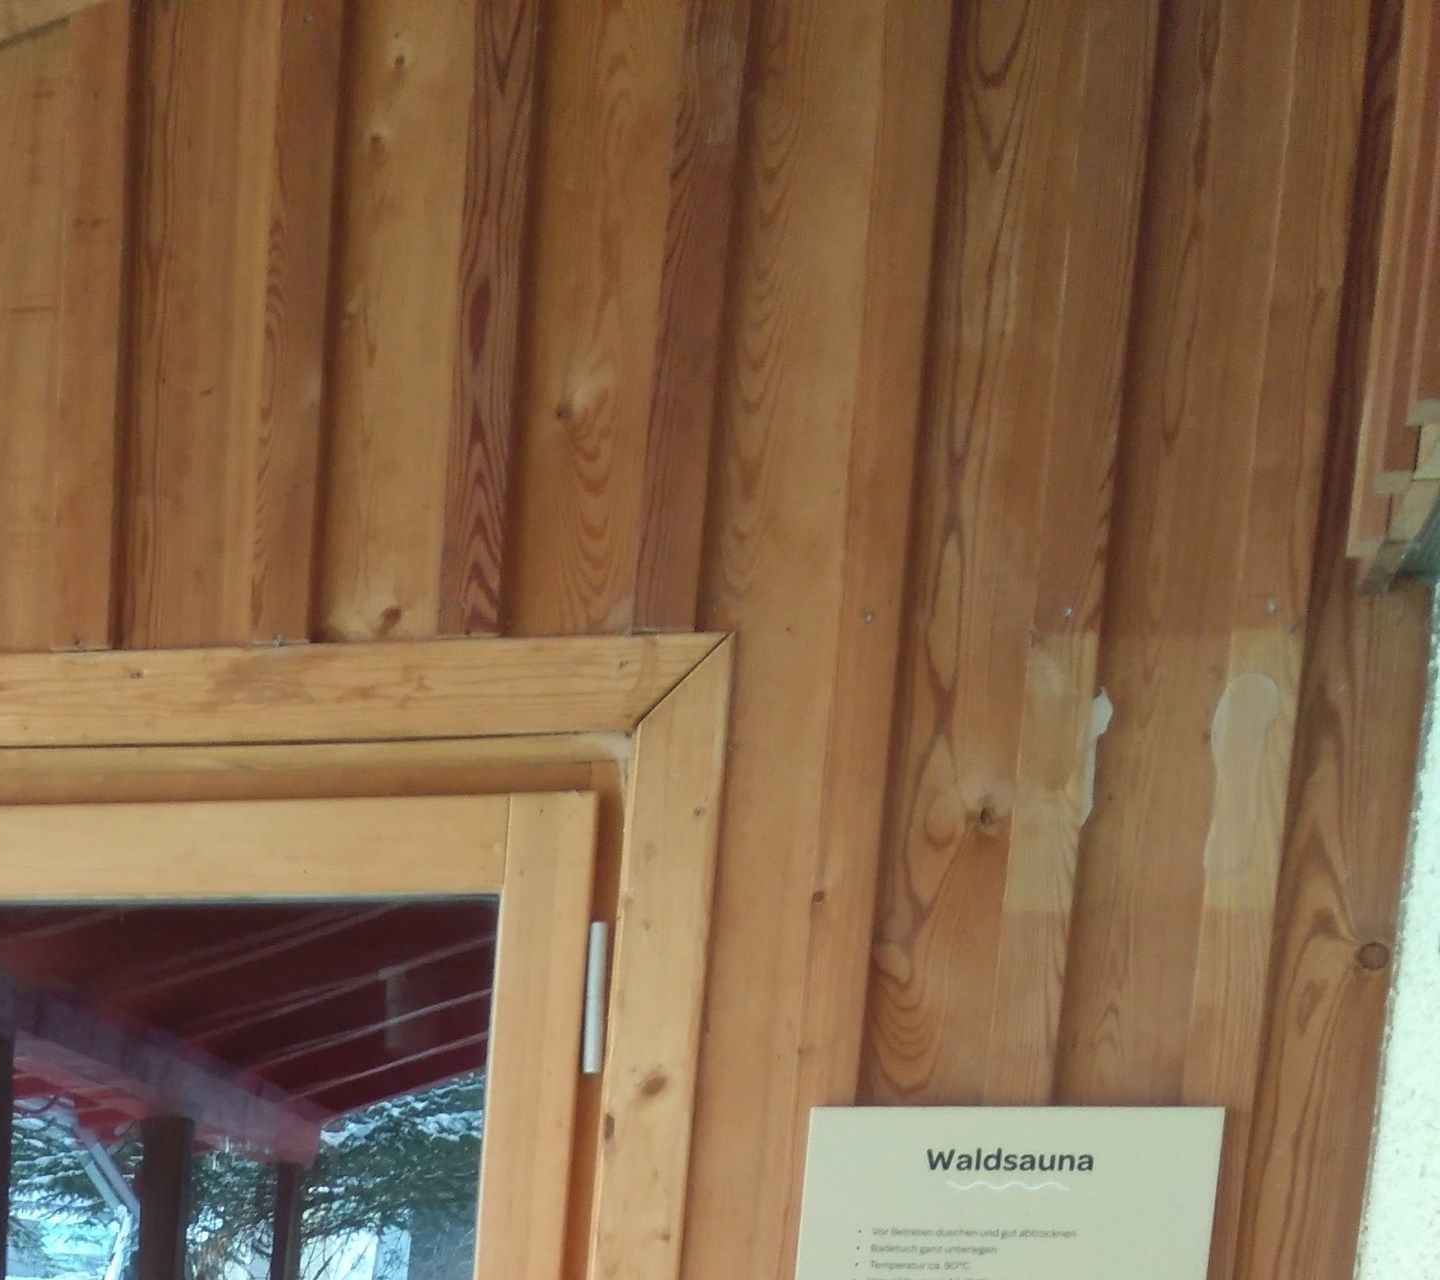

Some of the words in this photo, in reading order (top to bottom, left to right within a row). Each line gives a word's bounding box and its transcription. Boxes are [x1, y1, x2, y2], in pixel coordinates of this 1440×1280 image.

[926, 1147, 1094, 1172] Waldsauna
[872, 1228, 889, 1236] Vor
[935, 1229, 979, 1237] duschen
[980, 1229, 999, 1237] und
[1000, 1229, 1017, 1240] gut
[1019, 1230, 1077, 1238] abtrocknen
[944, 1245, 997, 1257] unterlegen
[870, 1261, 925, 1271] Temperatur
[944, 1261, 970, 1270] 90°C
